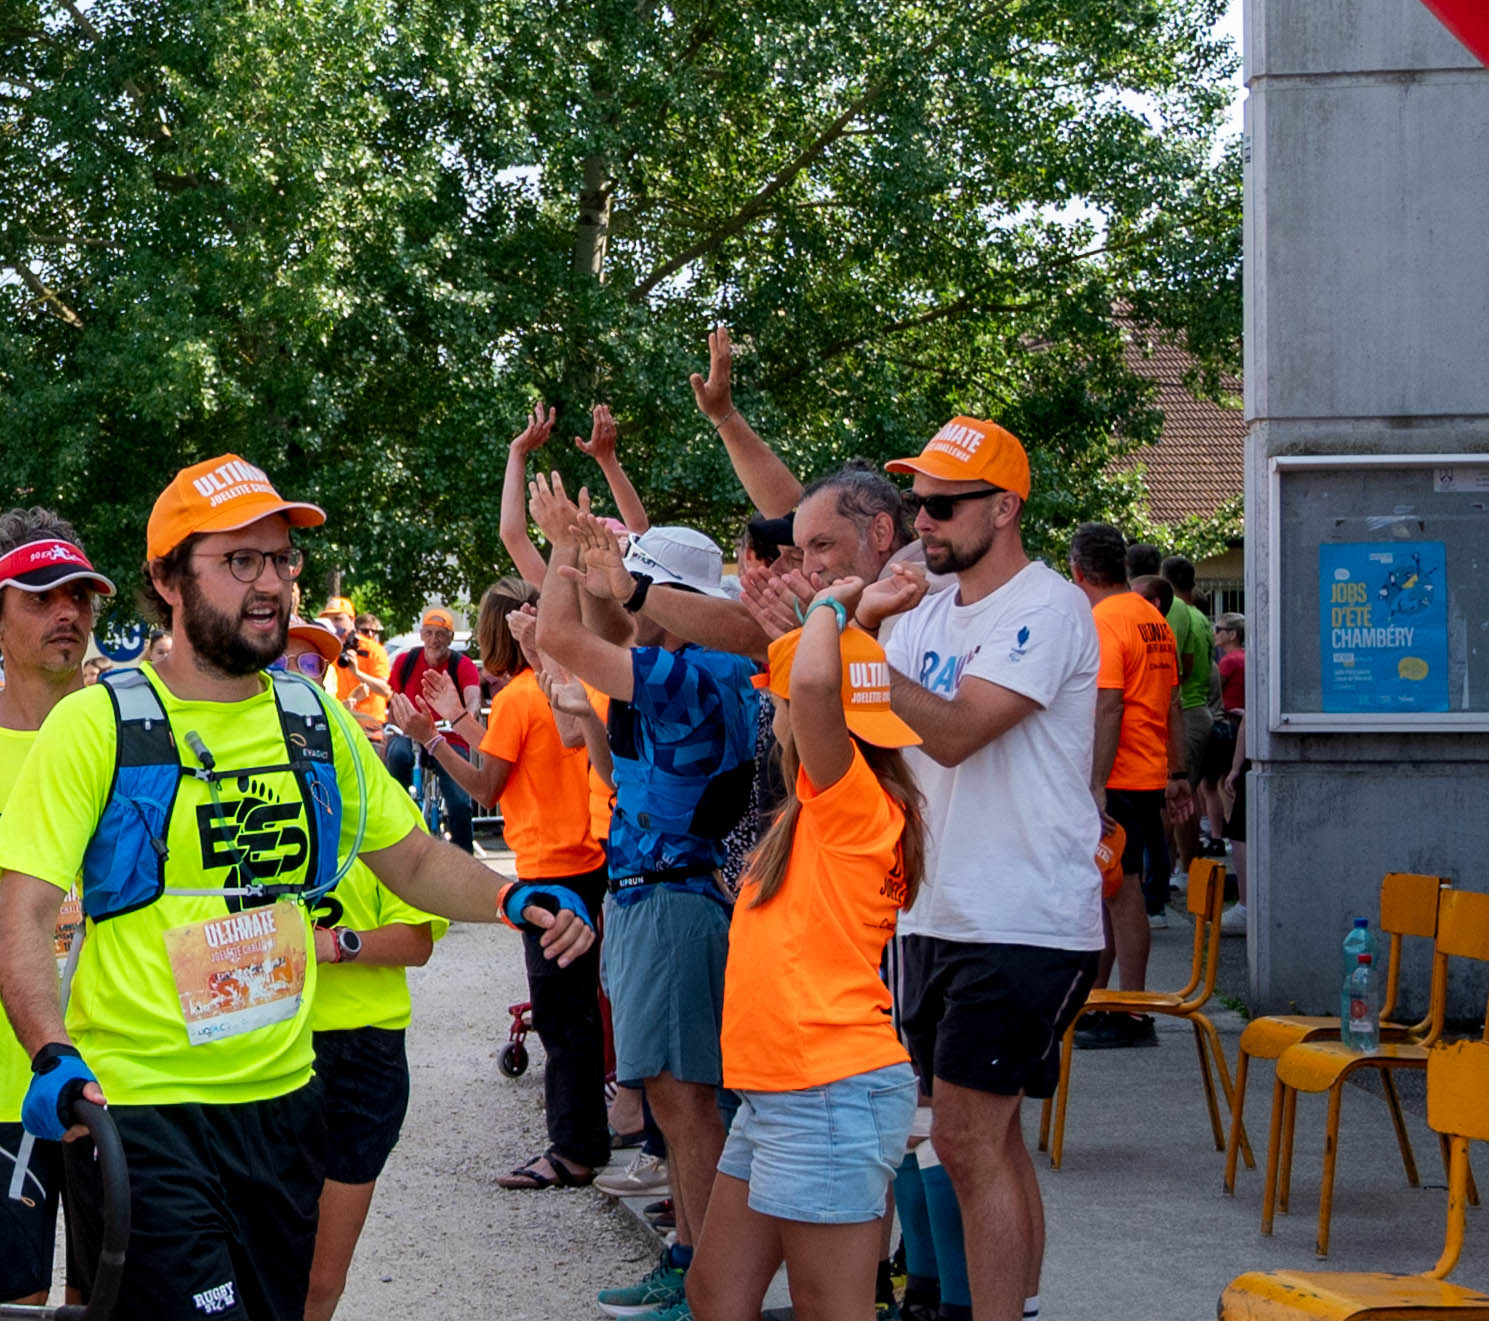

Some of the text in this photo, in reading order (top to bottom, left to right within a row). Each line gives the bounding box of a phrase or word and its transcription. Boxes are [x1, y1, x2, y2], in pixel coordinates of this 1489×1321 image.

[1330, 582, 1367, 603] JOBS
[1331, 602, 1372, 628] D'ÉTÉ
[1331, 624, 1414, 649] CHAMBÉRY
[849, 662, 891, 688] ULTI
[193, 1281, 234, 1309] RUGBY
